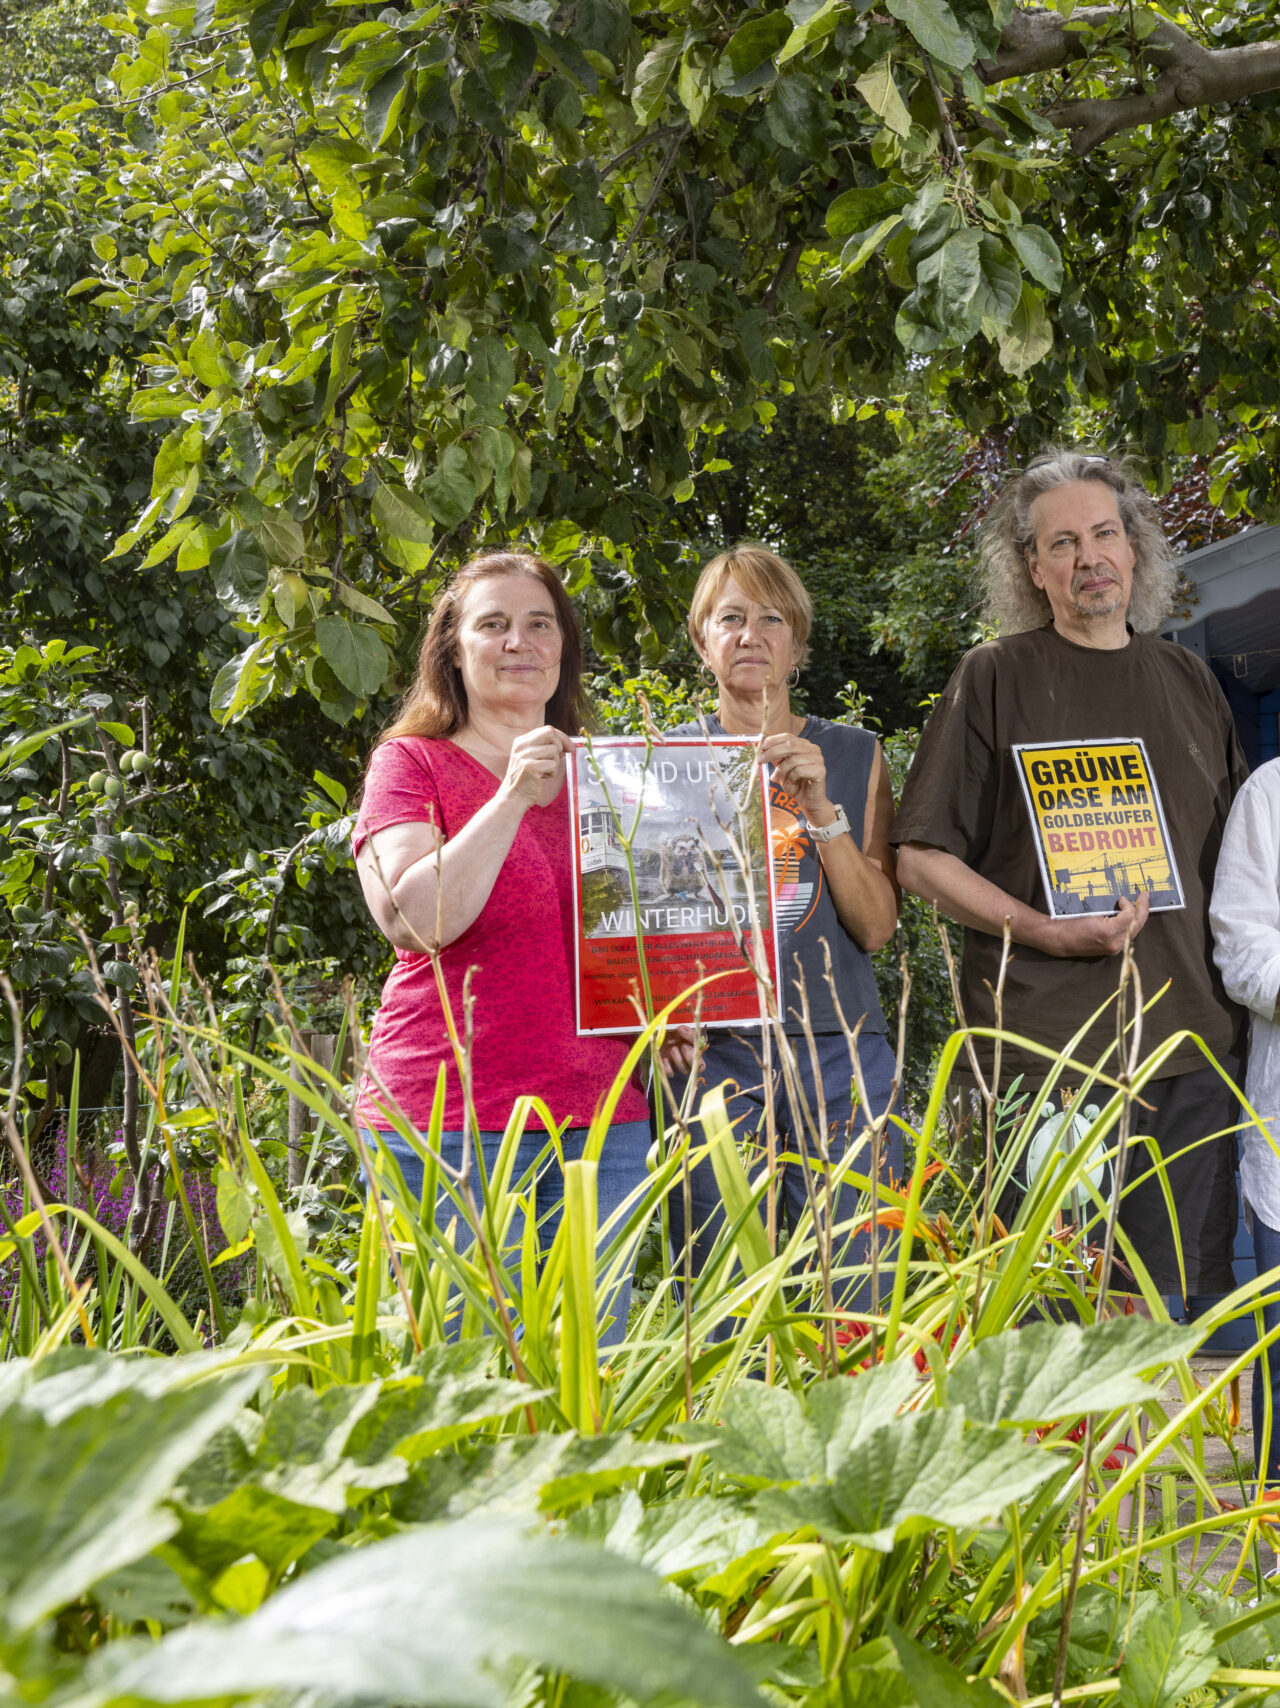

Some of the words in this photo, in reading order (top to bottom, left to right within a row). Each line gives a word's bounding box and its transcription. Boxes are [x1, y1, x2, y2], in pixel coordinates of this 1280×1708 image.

[1031, 752, 1143, 786] GRÜNE
[1038, 787, 1103, 811] OASE
[1111, 784, 1149, 806] AM
[1043, 809, 1154, 829] GOLDBEKUFER
[1047, 827, 1157, 853] BEDROHT
[592, 946, 608, 954] DAS
[612, 945, 630, 953] SOLL
[654, 942, 679, 950] ALLES
[714, 990, 740, 998] DIESER
